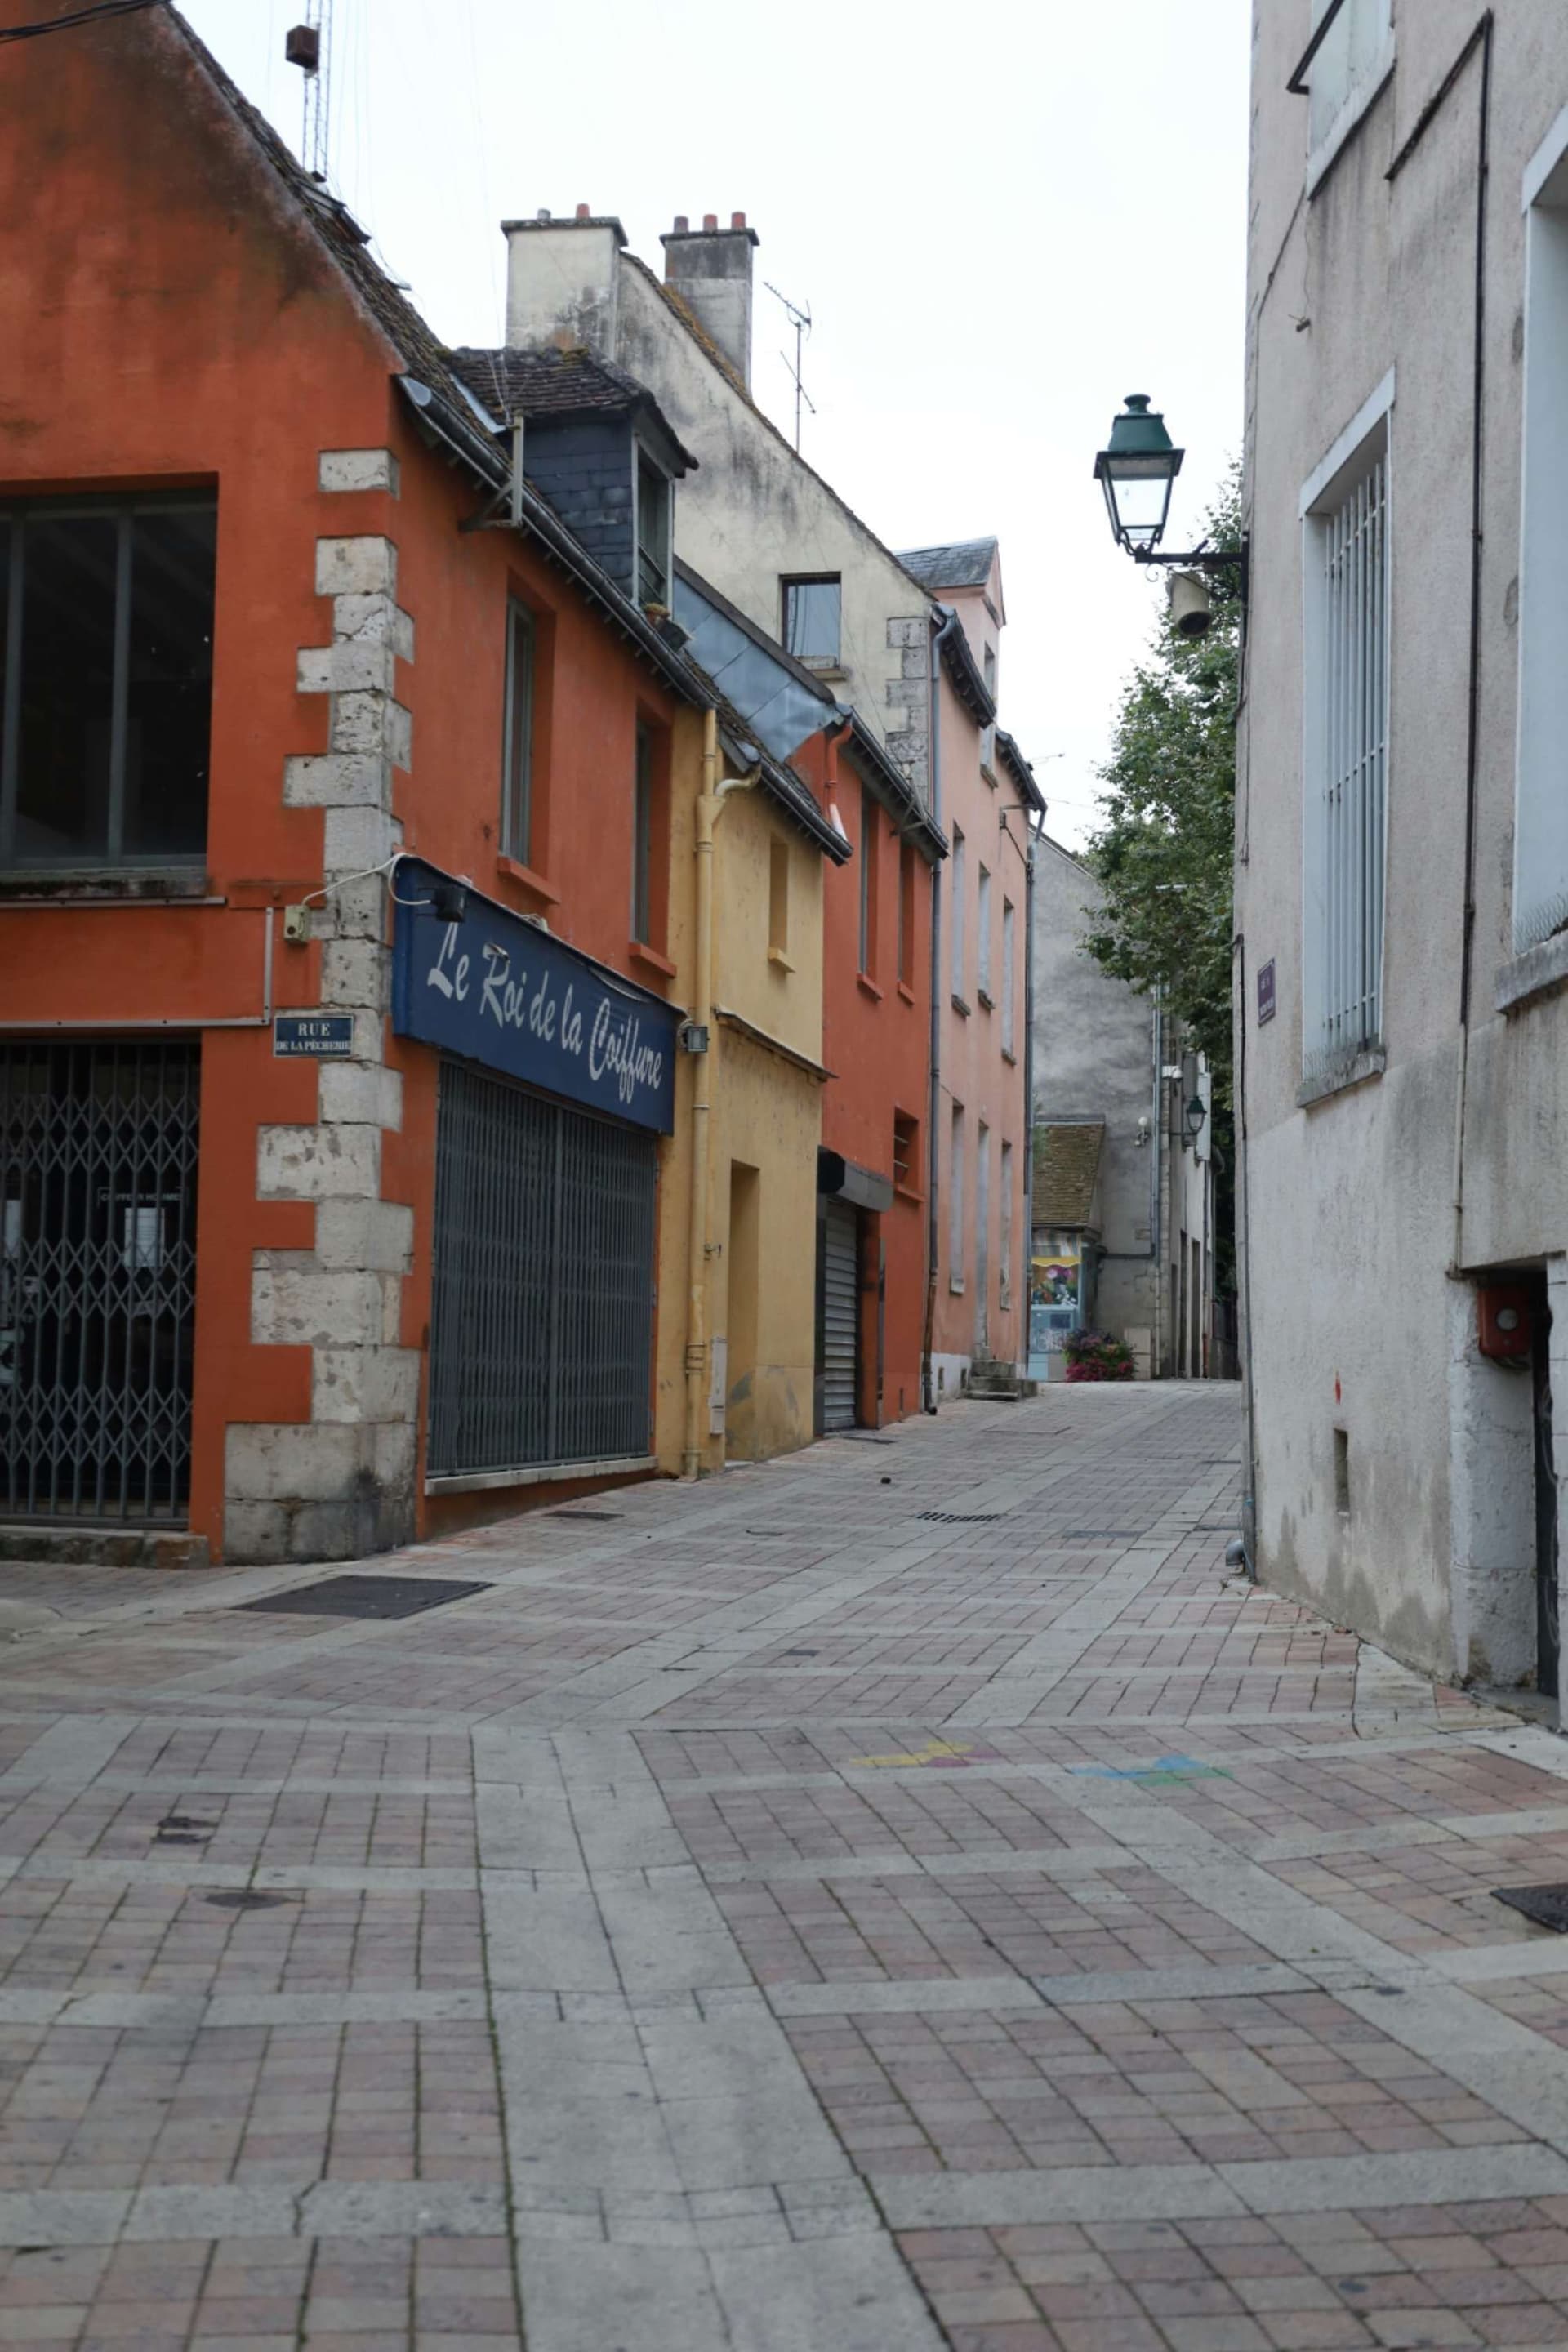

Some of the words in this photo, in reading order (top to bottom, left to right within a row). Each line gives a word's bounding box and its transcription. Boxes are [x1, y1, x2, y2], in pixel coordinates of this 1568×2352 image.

[427, 922, 470, 1001] Le
[479, 942, 528, 1028] Roi
[530, 969, 556, 1043] de
[561, 982, 583, 1056] la
[589, 997, 663, 1105] Coiffure
[298, 1022, 331, 1036] RUE
[277, 1040, 288, 1051] DE
[290, 1040, 303, 1051] LA
